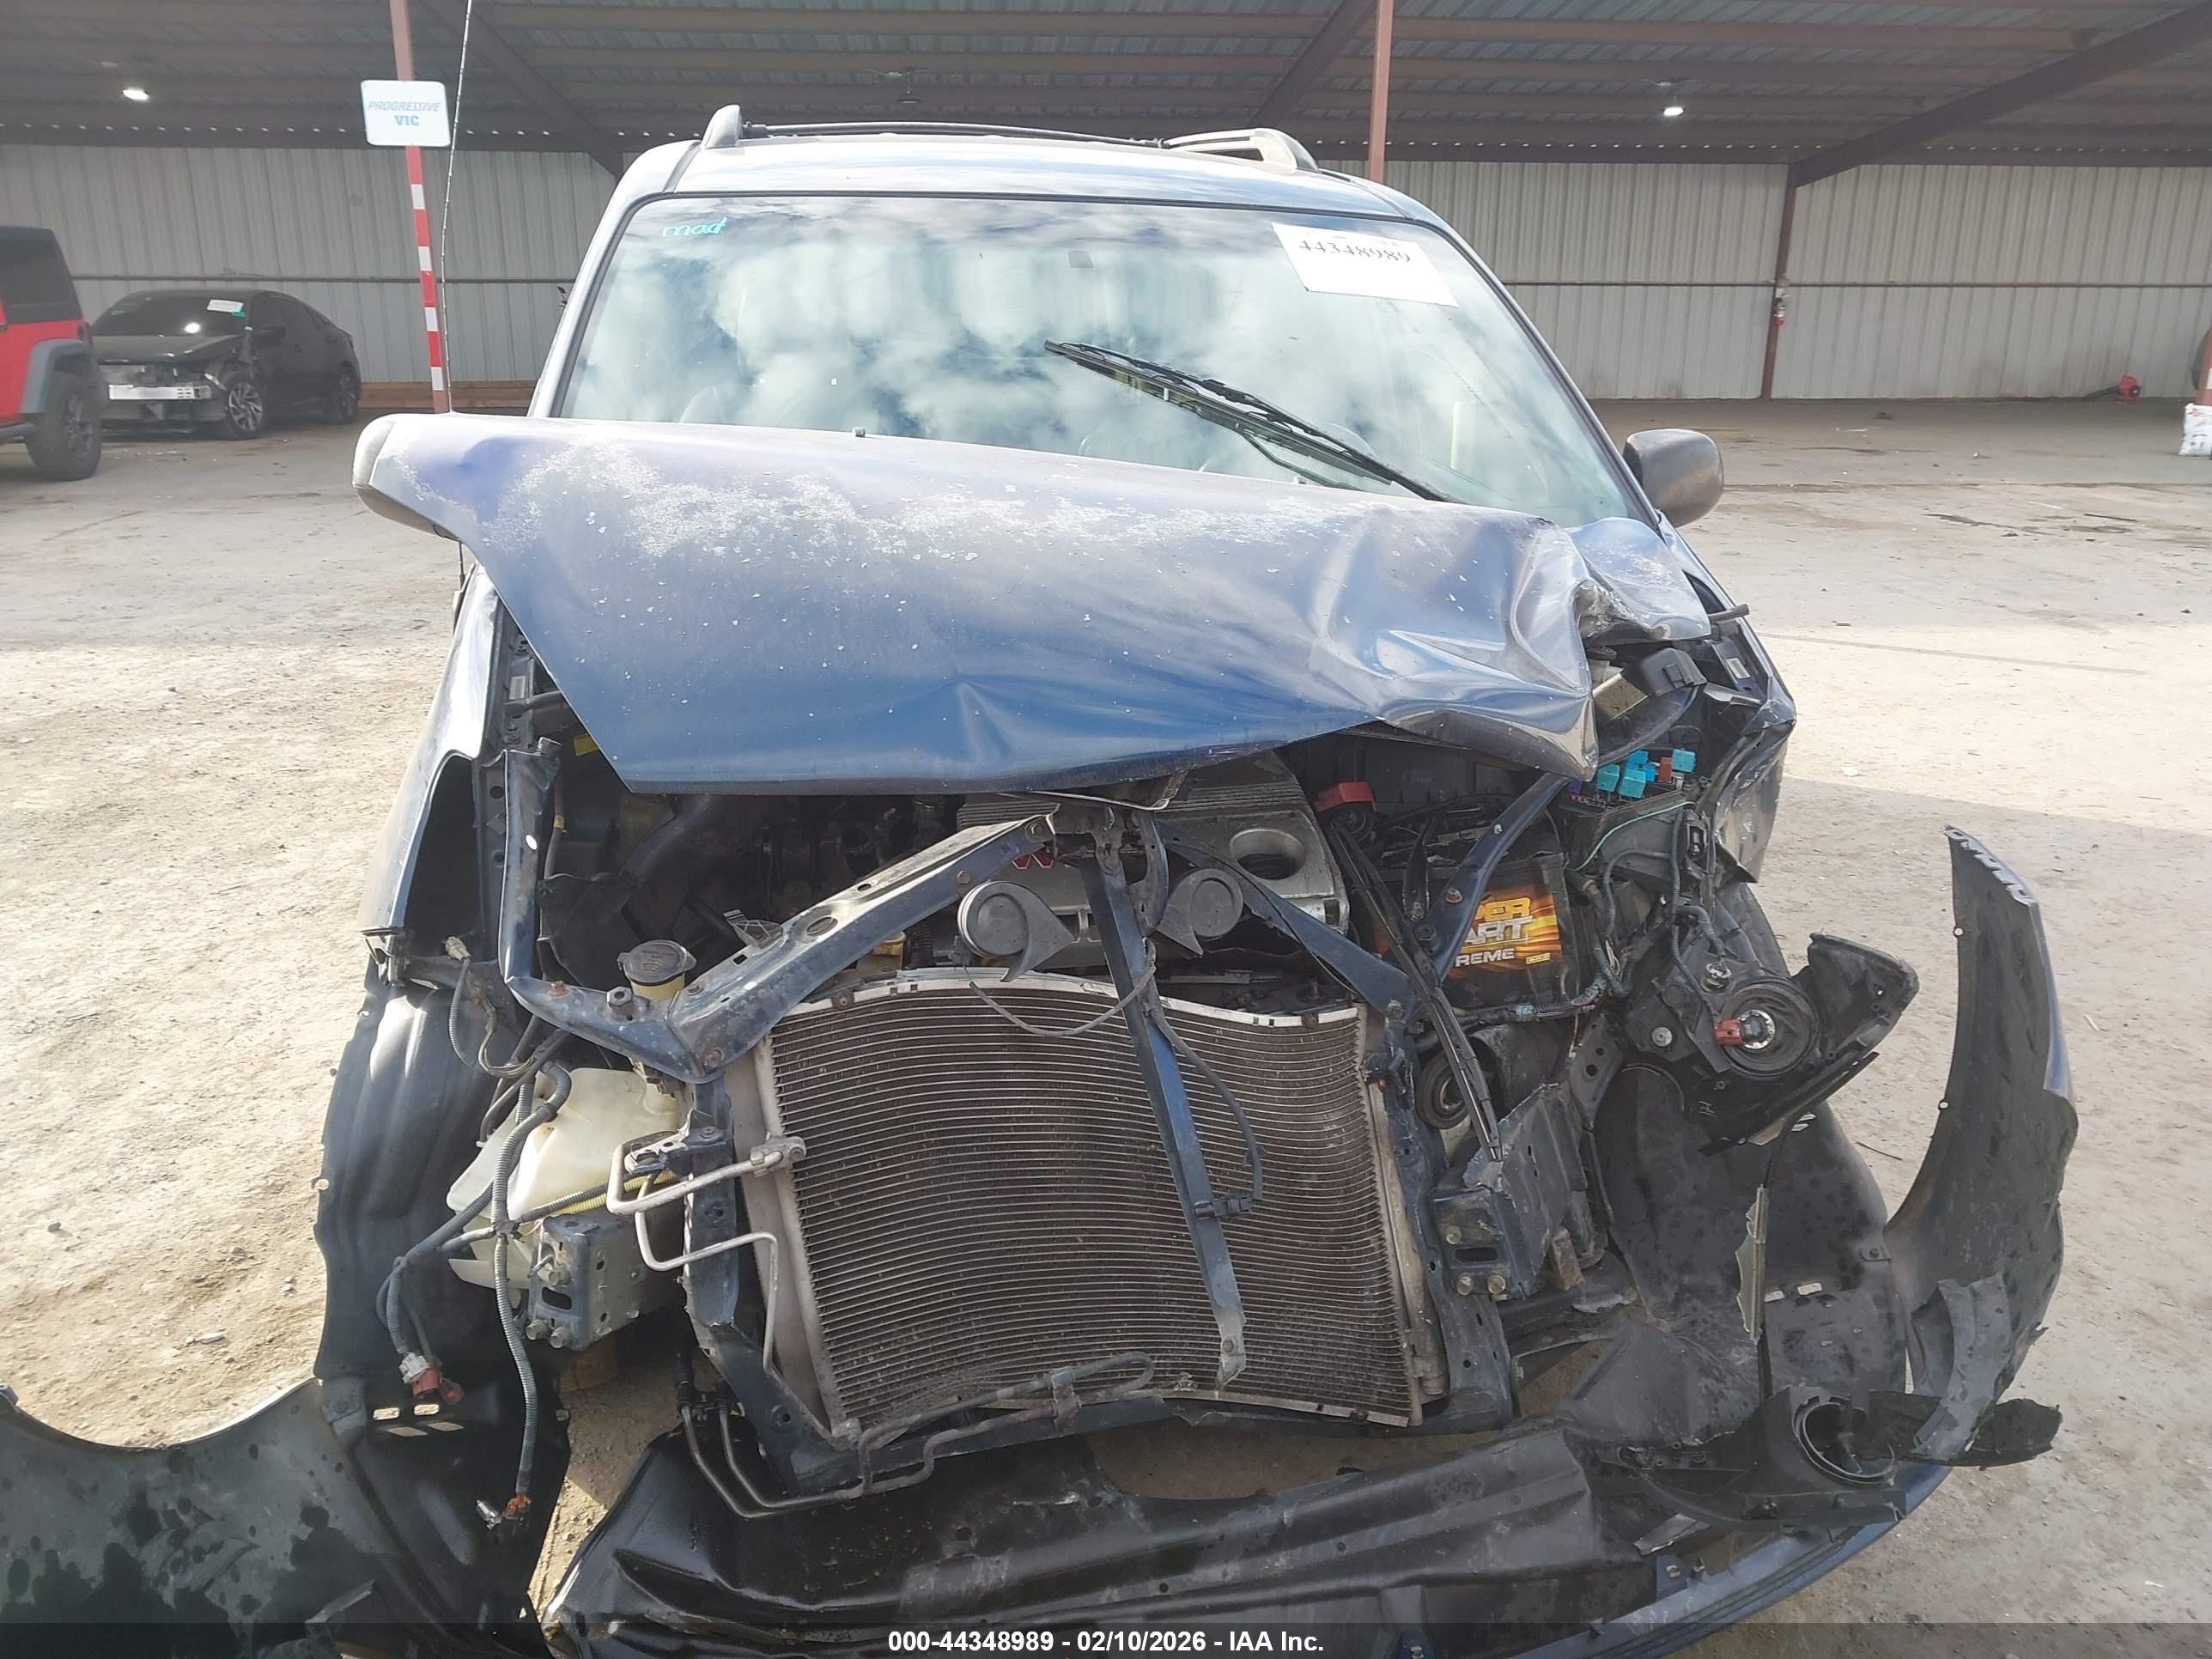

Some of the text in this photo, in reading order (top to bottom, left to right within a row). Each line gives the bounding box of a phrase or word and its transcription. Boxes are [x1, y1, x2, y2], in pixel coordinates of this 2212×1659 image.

[368, 100, 441, 112] PROGRESSIVE
[394, 115, 420, 126] VIC
[1298, 240, 1411, 263] 44348989
